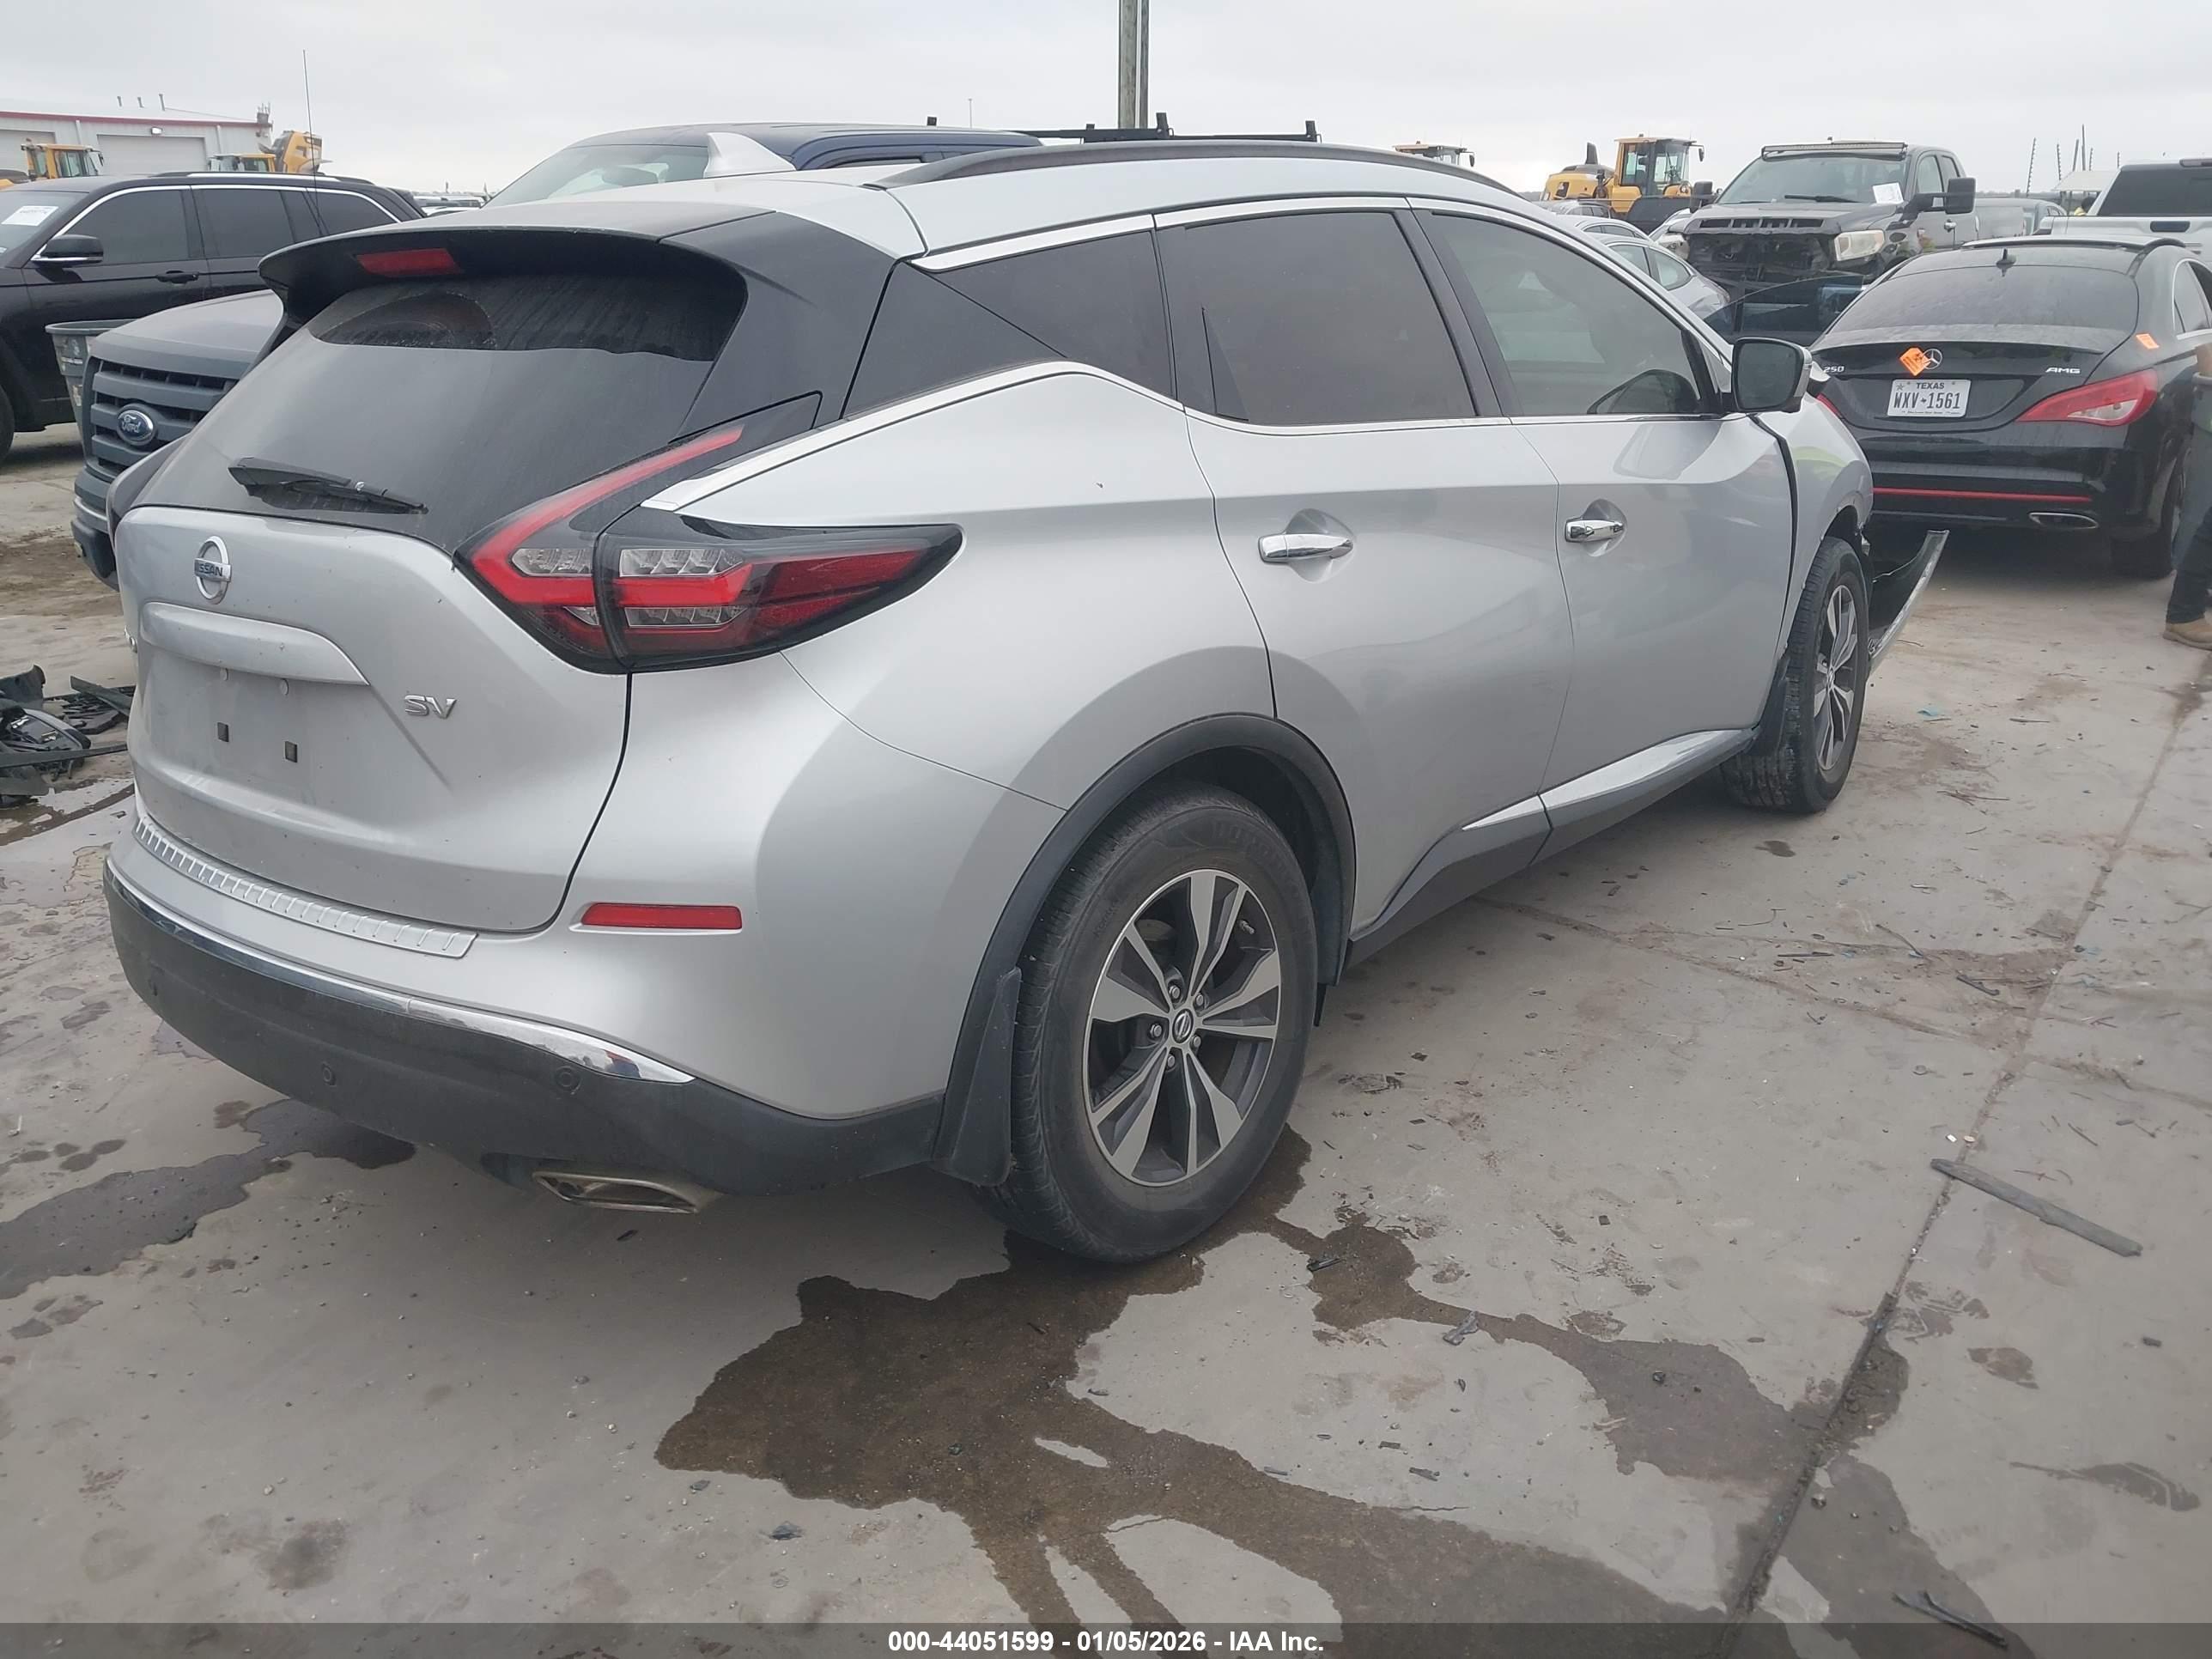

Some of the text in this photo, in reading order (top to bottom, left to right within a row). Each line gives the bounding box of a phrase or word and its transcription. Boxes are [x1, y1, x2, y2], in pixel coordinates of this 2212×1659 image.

[121, 414, 143, 434] Ford
[195, 561, 222, 576] ISSAN
[404, 694, 457, 719] SV
